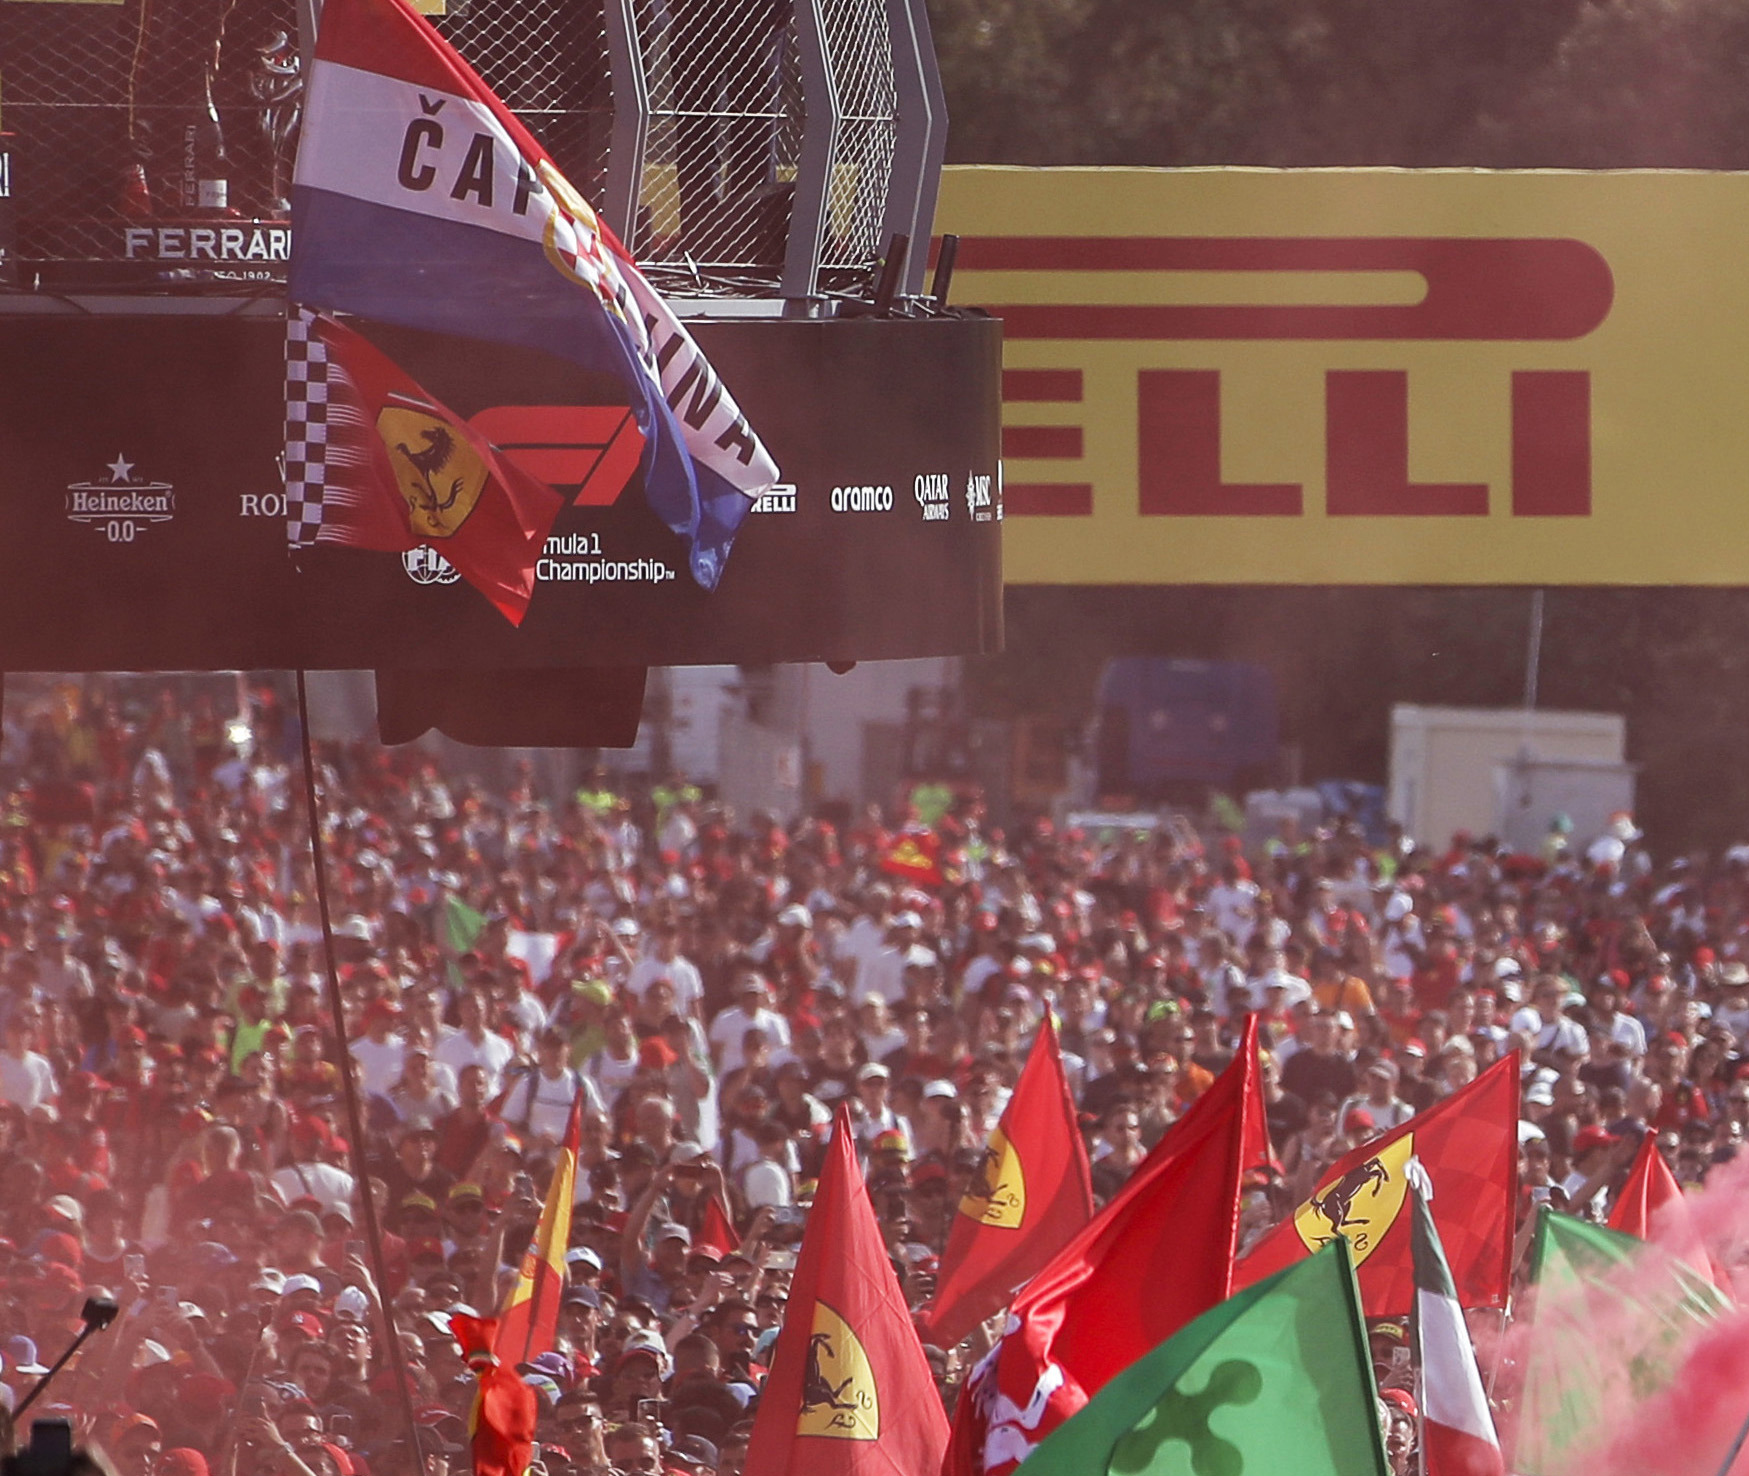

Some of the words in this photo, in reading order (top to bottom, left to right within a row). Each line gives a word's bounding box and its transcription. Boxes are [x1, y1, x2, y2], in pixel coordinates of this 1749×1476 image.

[72, 492, 168, 512] Heineken
[831, 486, 894, 512] aramco
[914, 474, 949, 506] QATAR
[107, 520, 135, 542] 0.0
